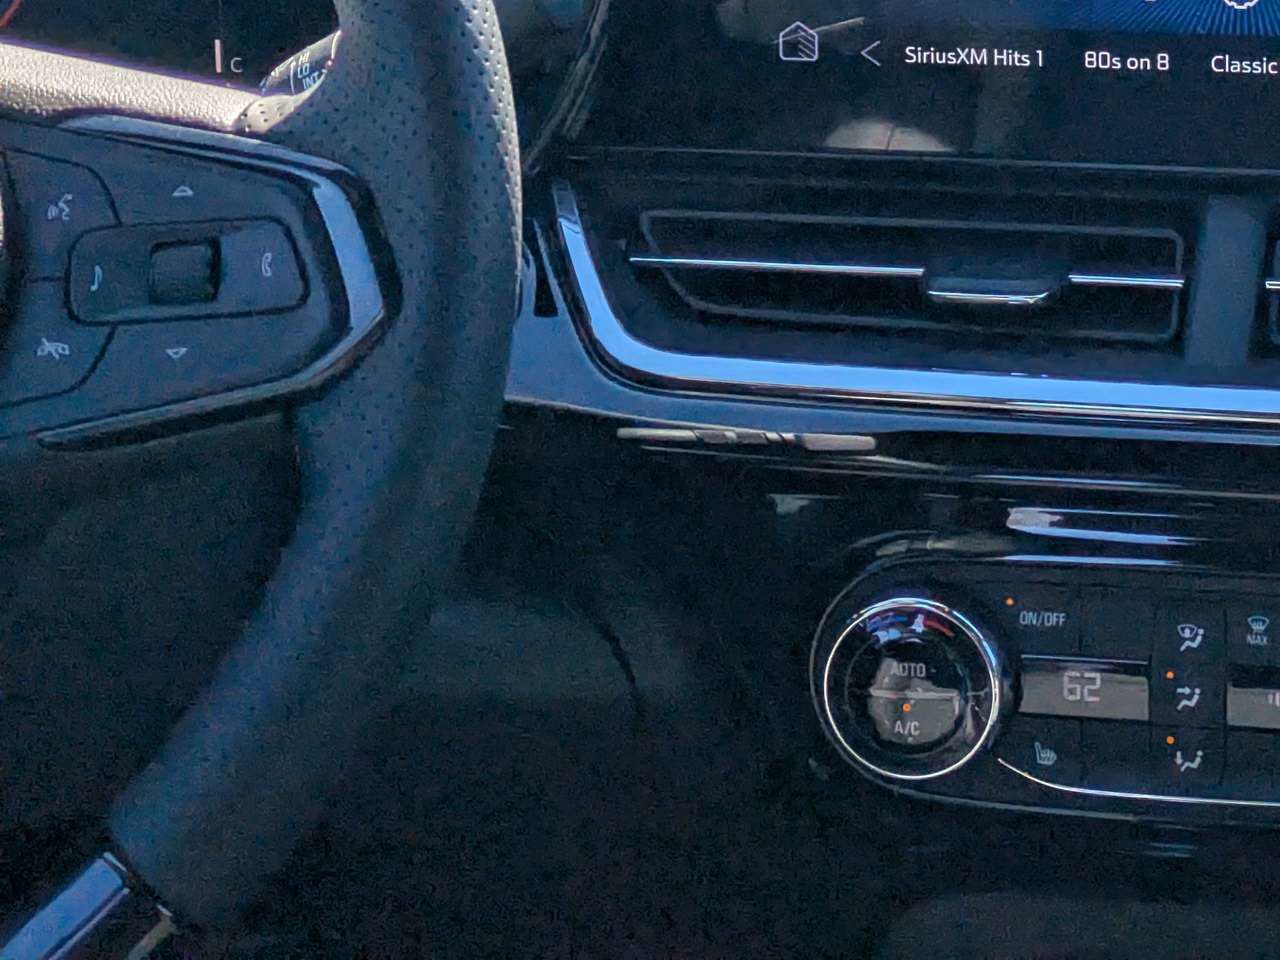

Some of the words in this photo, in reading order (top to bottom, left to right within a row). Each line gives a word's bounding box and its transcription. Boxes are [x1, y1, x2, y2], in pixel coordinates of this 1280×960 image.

[230, 57, 243, 73] C
[904, 46, 988, 66] SiriusXM
[993, 49, 1031, 67] Hits
[1036, 50, 1044, 67] 1
[1084, 51, 1122, 69] 80s
[1126, 56, 1151, 70] on
[1157, 53, 1170, 71] 8
[1210, 55, 1278, 74] Classic
[298, 63, 310, 79] LO
[303, 71, 320, 90] INT
[1019, 611, 1067, 627] ON/OFF
[1063, 671, 1101, 702] 62
[894, 721, 920, 735] A/C
